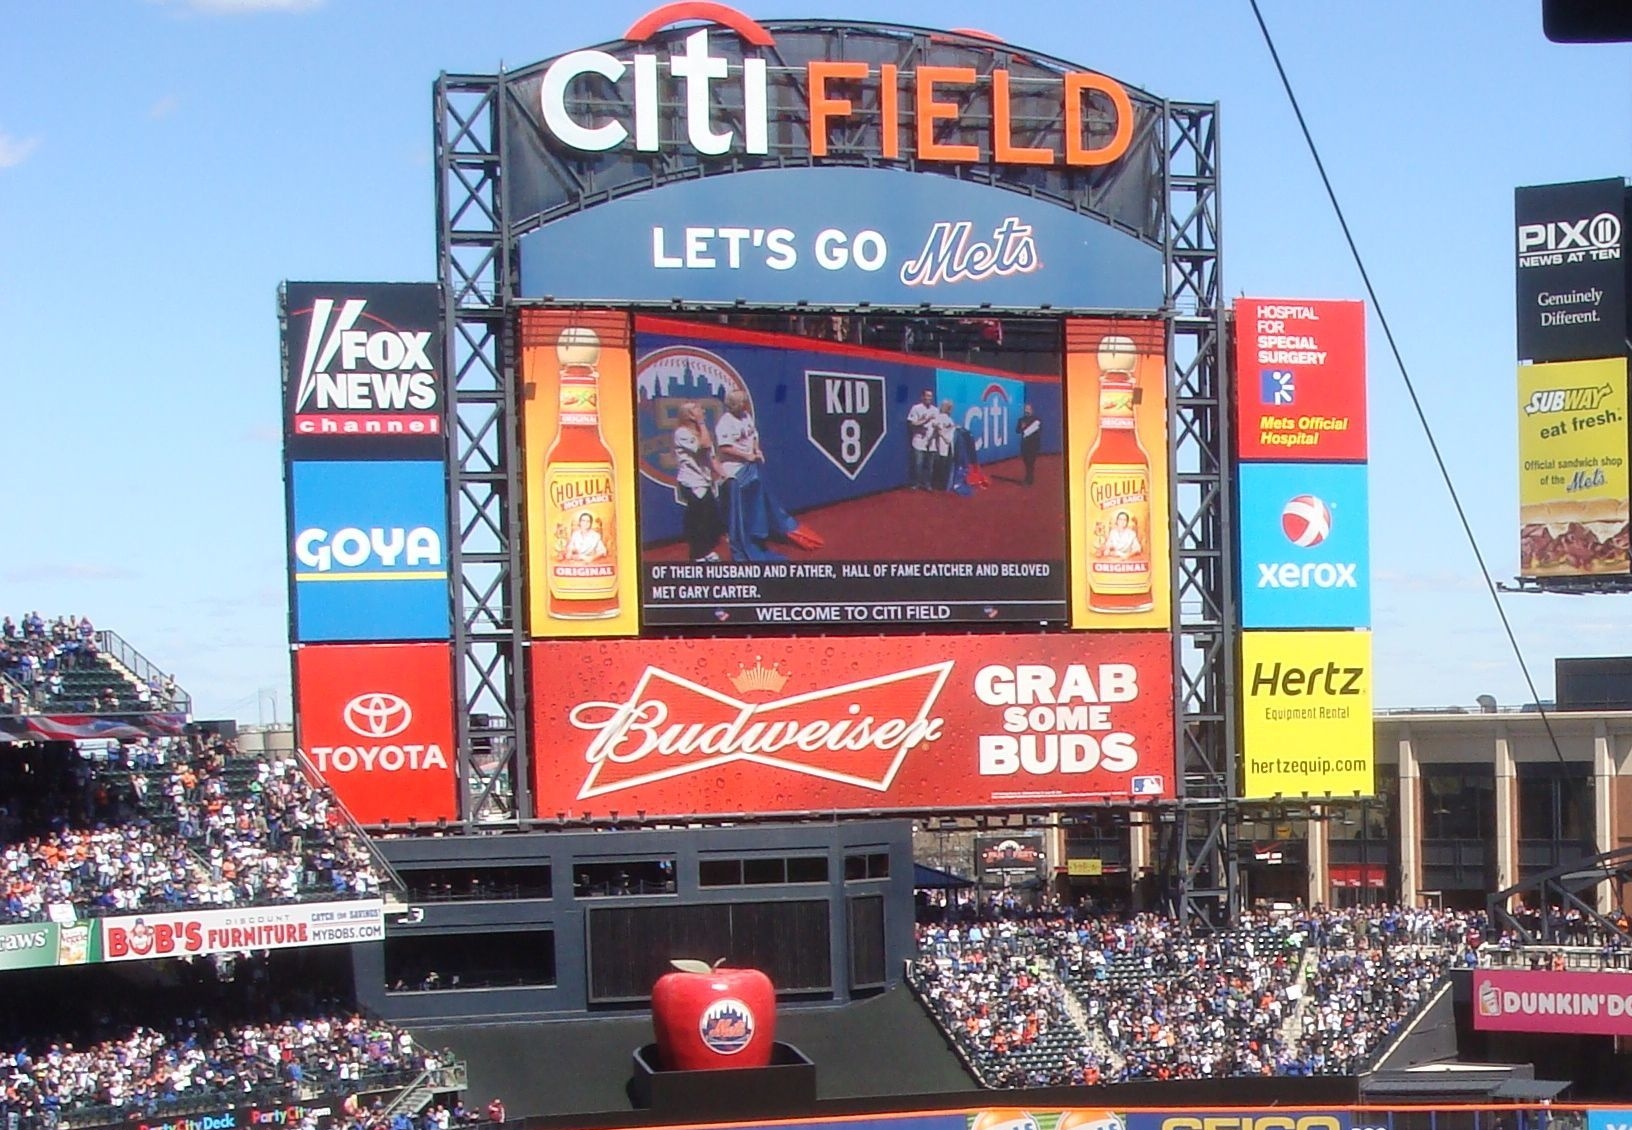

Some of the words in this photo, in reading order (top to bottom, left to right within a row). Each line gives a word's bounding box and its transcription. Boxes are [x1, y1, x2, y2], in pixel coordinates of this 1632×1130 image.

[541, 29, 767, 156] citi
[807, 62, 1133, 167] FIELD
[652, 226, 797, 270] LET'S
[814, 227, 888, 272] GO
[899, 215, 1040, 288] Mets
[1519, 254, 1563, 267] NEWS
[1567, 252, 1586, 263] AT
[1590, 248, 1621, 260] TEN
[1538, 287, 1603, 306] Genuinely
[1257, 305, 1320, 320] HOSPITAL
[1541, 310, 1601, 326] Different.
[1257, 319, 1285, 334] FOR
[341, 330, 434, 371] FOX
[1257, 335, 1318, 350] SPECIAL
[1257, 350, 1327, 365] SURGERY
[315, 372, 437, 411] NEWS
[825, 381, 870, 413] KID
[1524, 384, 1613, 417] SUBWAY
[299, 417, 438, 434] channel
[1260, 416, 1296, 430] Mets
[1298, 416, 1348, 431] Official
[1540, 421, 1568, 439] eat
[1572, 410, 1623, 432] fresh.
[840, 420, 862, 463] 8
[1261, 432, 1319, 448] Hospital
[1524, 459, 1556, 471] Official
[1558, 457, 1599, 469] sandwich
[1602, 456, 1623, 467] shop
[1540, 475, 1549, 486] of
[1552, 475, 1565, 485] the
[1567, 468, 1605, 493] Mets
[550, 478, 613, 508] CHOLULA
[1091, 479, 1148, 508] CHOLULA
[296, 526, 442, 571] GOYA
[555, 567, 613, 577] ORIGINAL
[652, 566, 668, 579] OF
[670, 566, 703, 579] THEIR
[706, 565, 760, 578] HUSBAND
[763, 565, 787, 578] AND
[789, 565, 837, 580] FATHER,
[842, 565, 871, 578] HALL
[873, 565, 888, 578] OF
[891, 564, 921, 577] FAME
[923, 564, 973, 577] CATCHER
[975, 564, 999, 577] AND
[1001, 564, 1050, 577] BELOVED
[1094, 563, 1147, 573] ORIGINAL
[1257, 562, 1357, 588] xerox
[652, 586, 677, 599] MET
[678, 585, 709, 599] GARY
[712, 585, 762, 599] CARTER.
[756, 607, 841, 621] WELCOME
[844, 606, 868, 620] TO
[872, 606, 902, 620] CITI
[906, 606, 951, 620] FIELD
[974, 664, 1139, 706] GRAB
[1251, 662, 1364, 697] Hertz
[1003, 706, 1113, 732] SOME
[1264, 705, 1317, 723] Equipment
[1319, 705, 1350, 720] Rental
[570, 699, 944, 767] Budweiser
[312, 744, 448, 772] TOYOTA
[978, 733, 1139, 776] BUDS
[1250, 756, 1367, 776] hertzequip.com
[225, 914, 291, 925] DISCOUNT
[311, 911, 335, 922] CATCH
[208, 923, 309, 950] FURNITURE
[312, 925, 382, 941] MYBOBS.COM
[1504, 991, 1609, 1016] DUNKIN'
